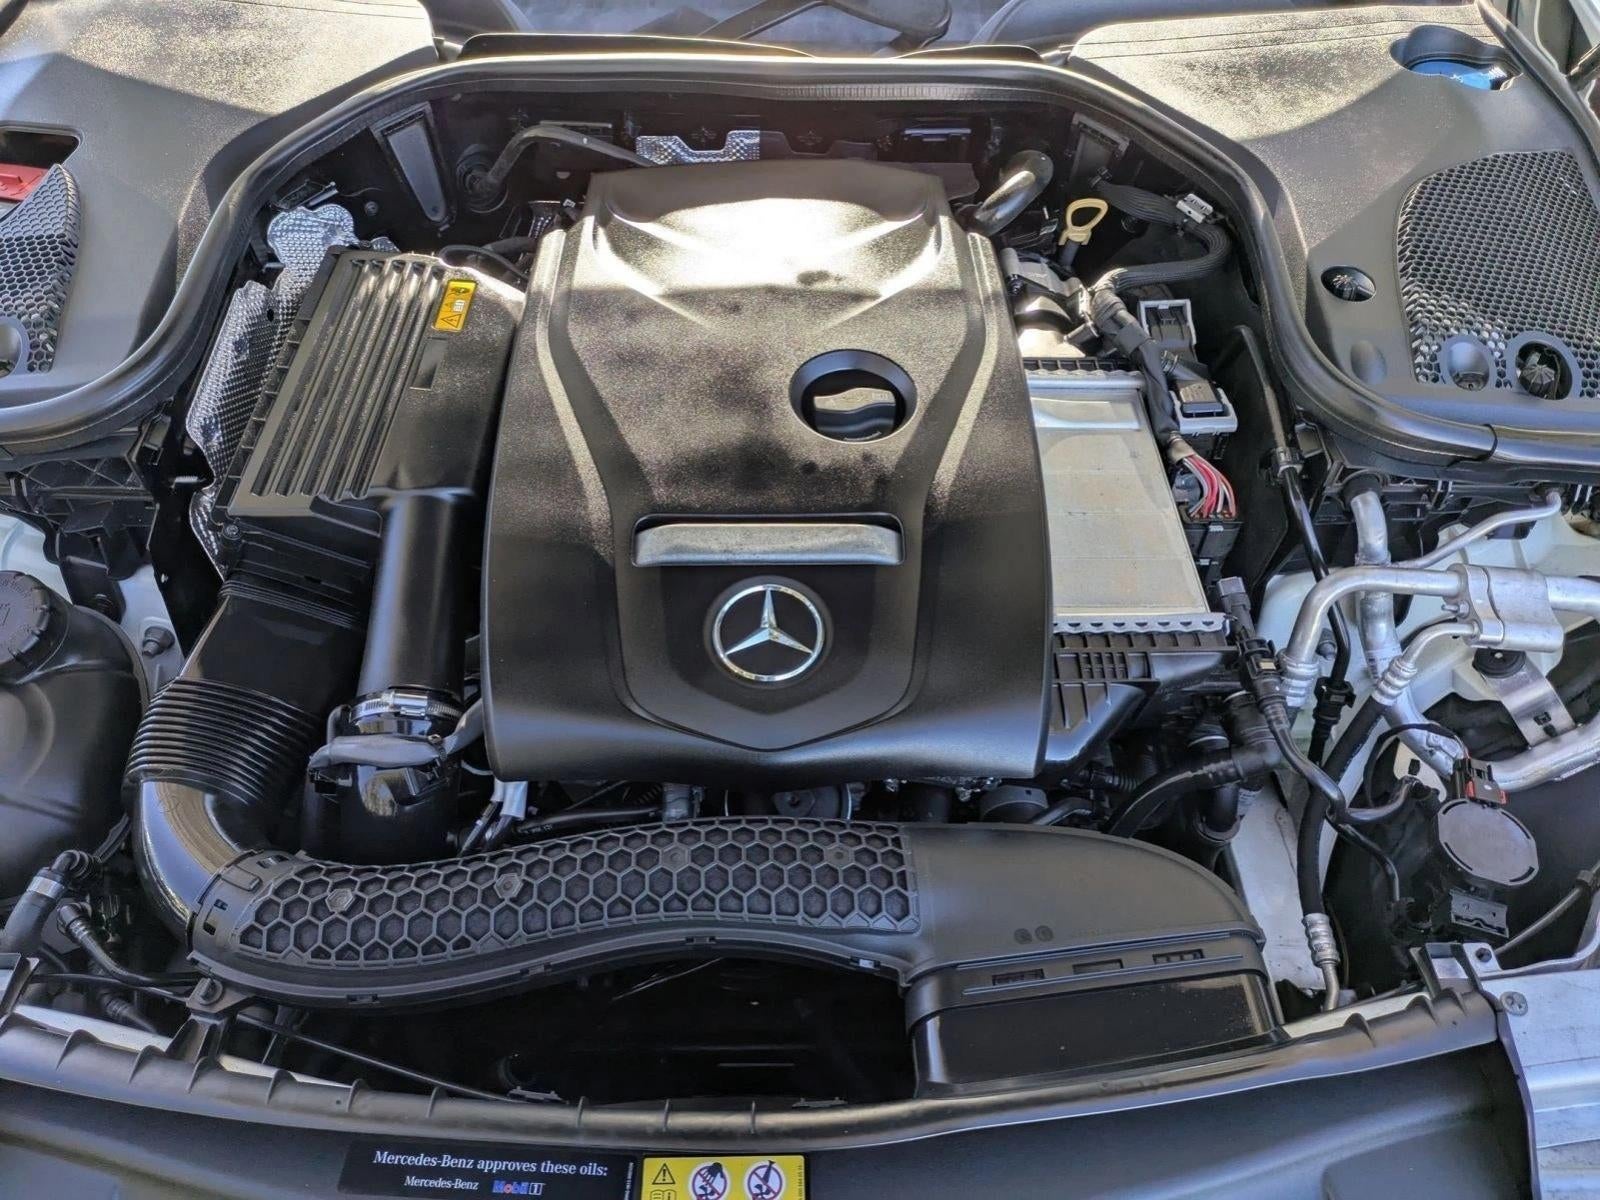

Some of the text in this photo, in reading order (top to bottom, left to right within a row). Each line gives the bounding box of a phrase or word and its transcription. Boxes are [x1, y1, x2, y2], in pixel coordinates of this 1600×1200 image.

[373, 1150, 609, 1177] Mercedes-Benz approves these oils:
[403, 1175, 480, 1191] Mercedes-Benz
[492, 1180, 529, 1195] Mobil
